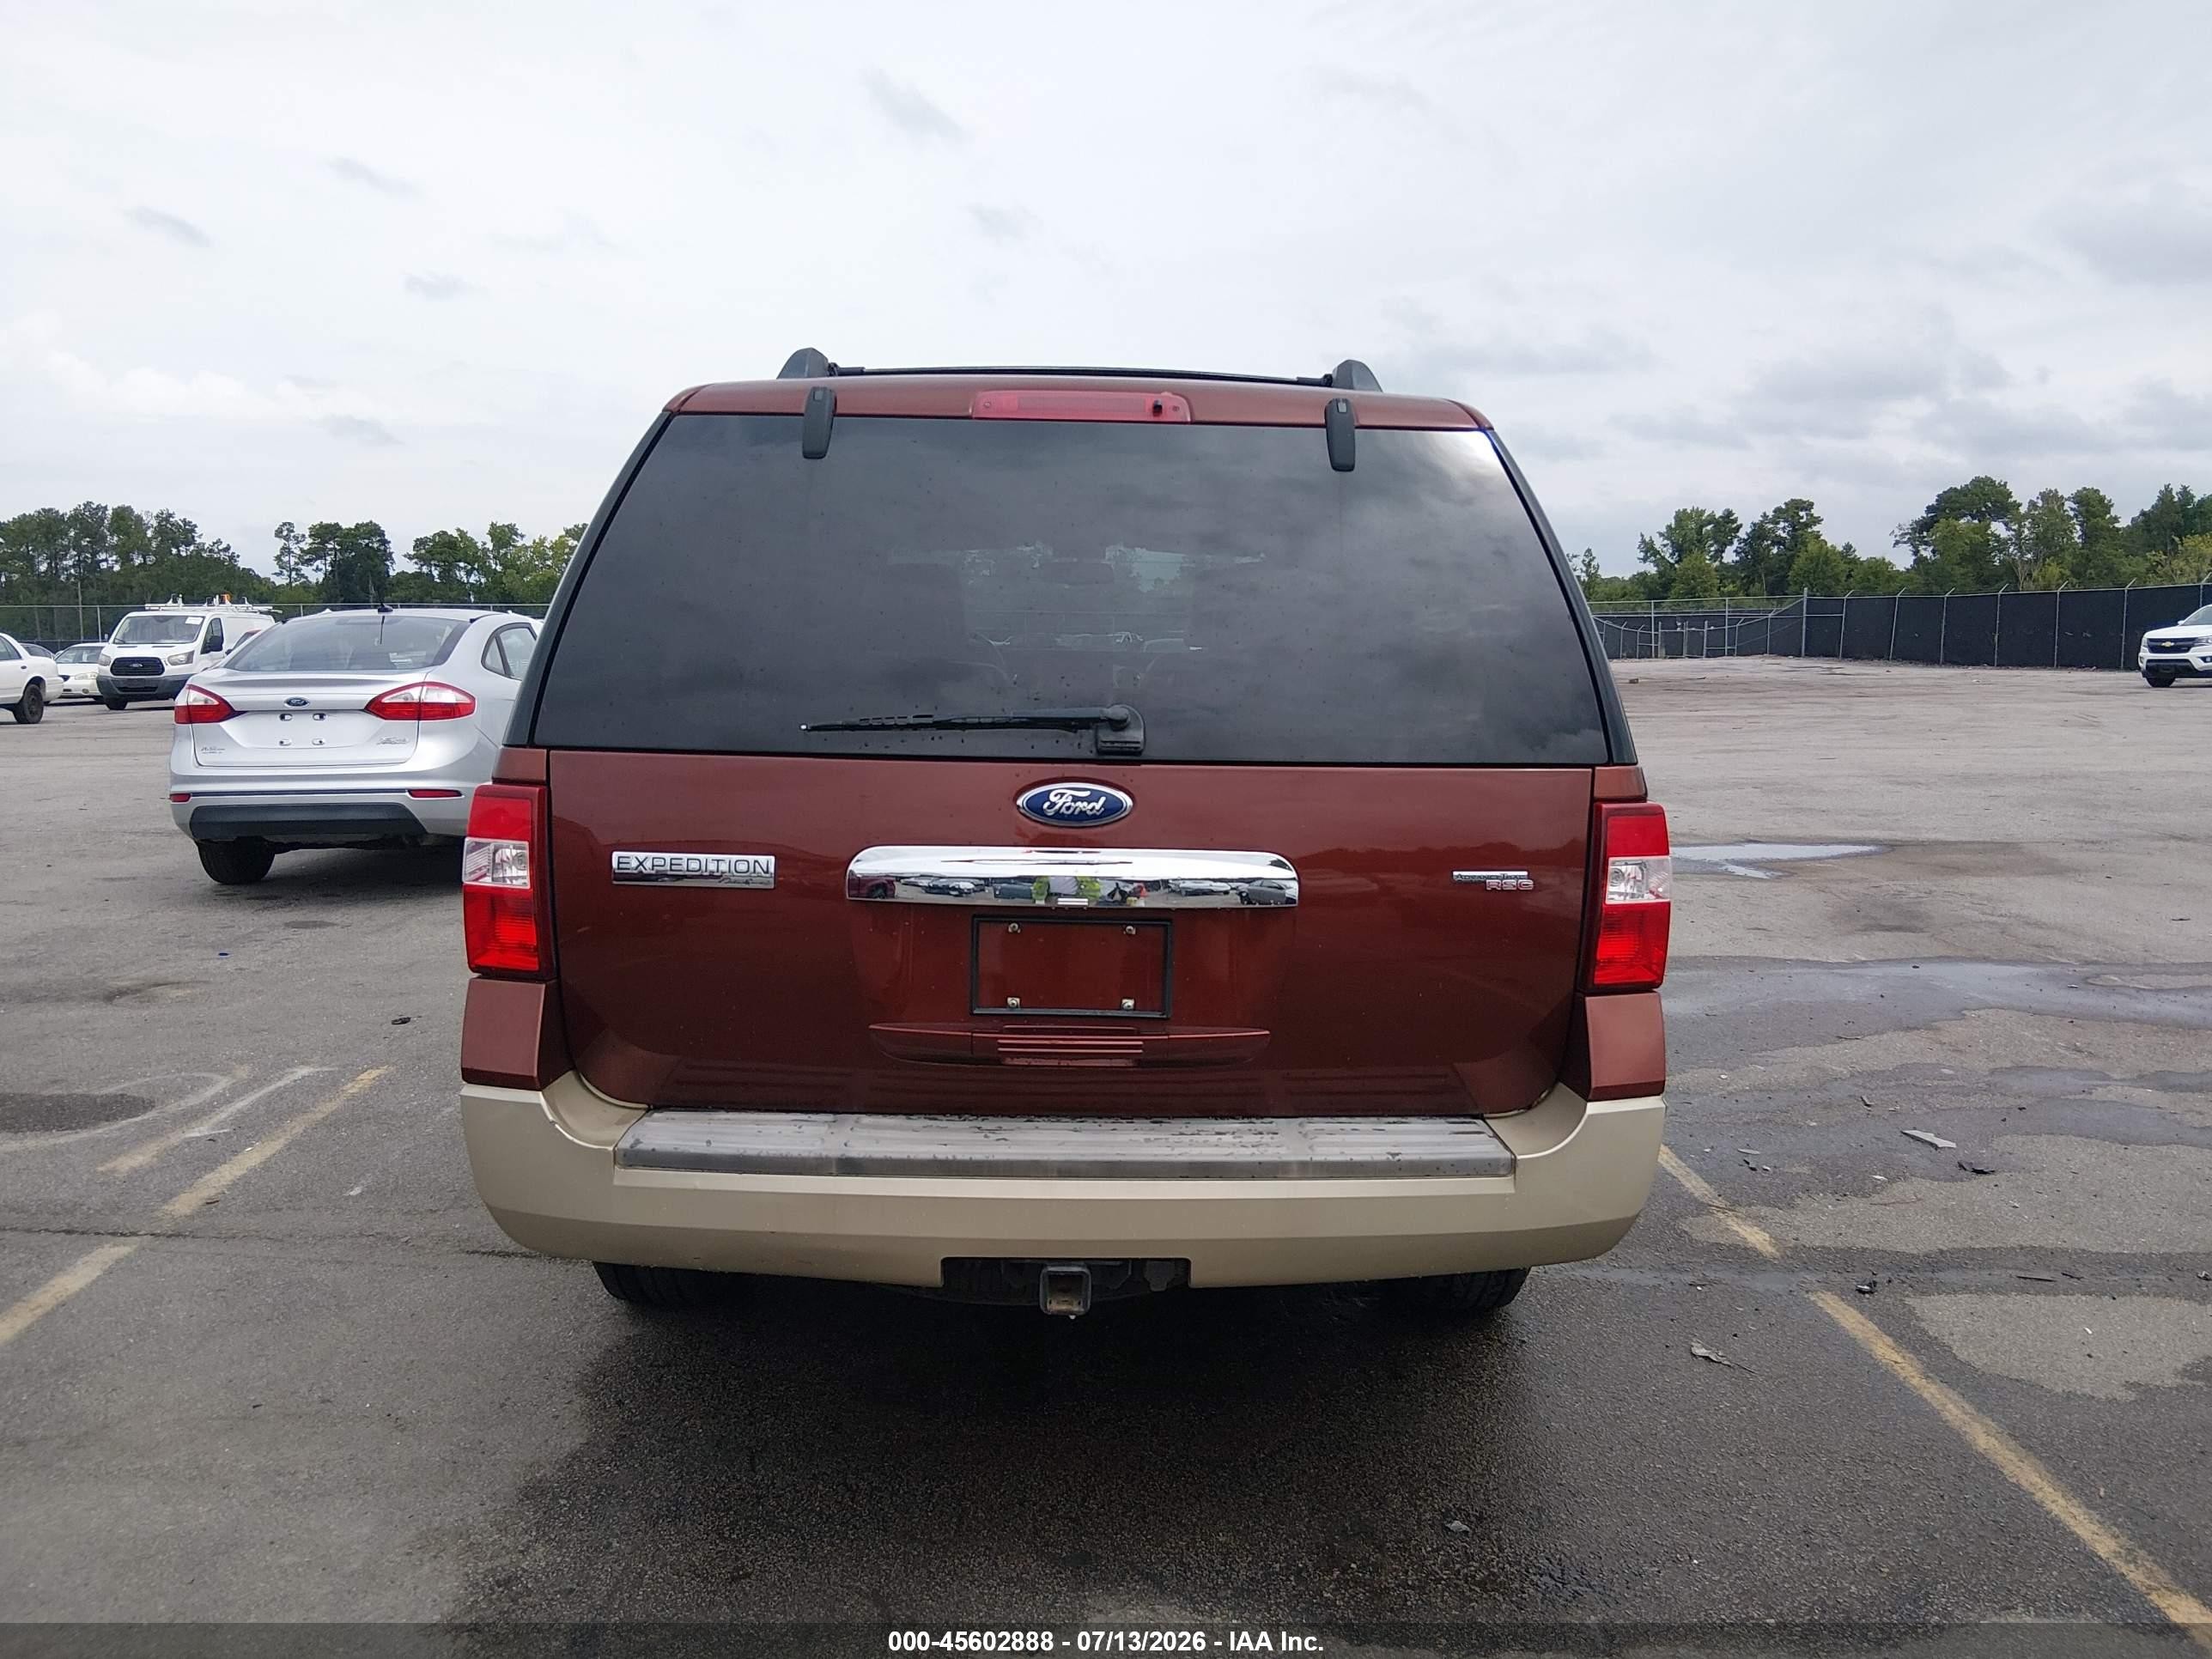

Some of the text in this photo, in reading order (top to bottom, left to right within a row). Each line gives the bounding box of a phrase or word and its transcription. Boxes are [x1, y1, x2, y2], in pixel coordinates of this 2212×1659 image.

[1042, 788, 1106, 816] Ford
[617, 855, 769, 875] EXPEDITION
[1486, 879, 1534, 890] RSC
